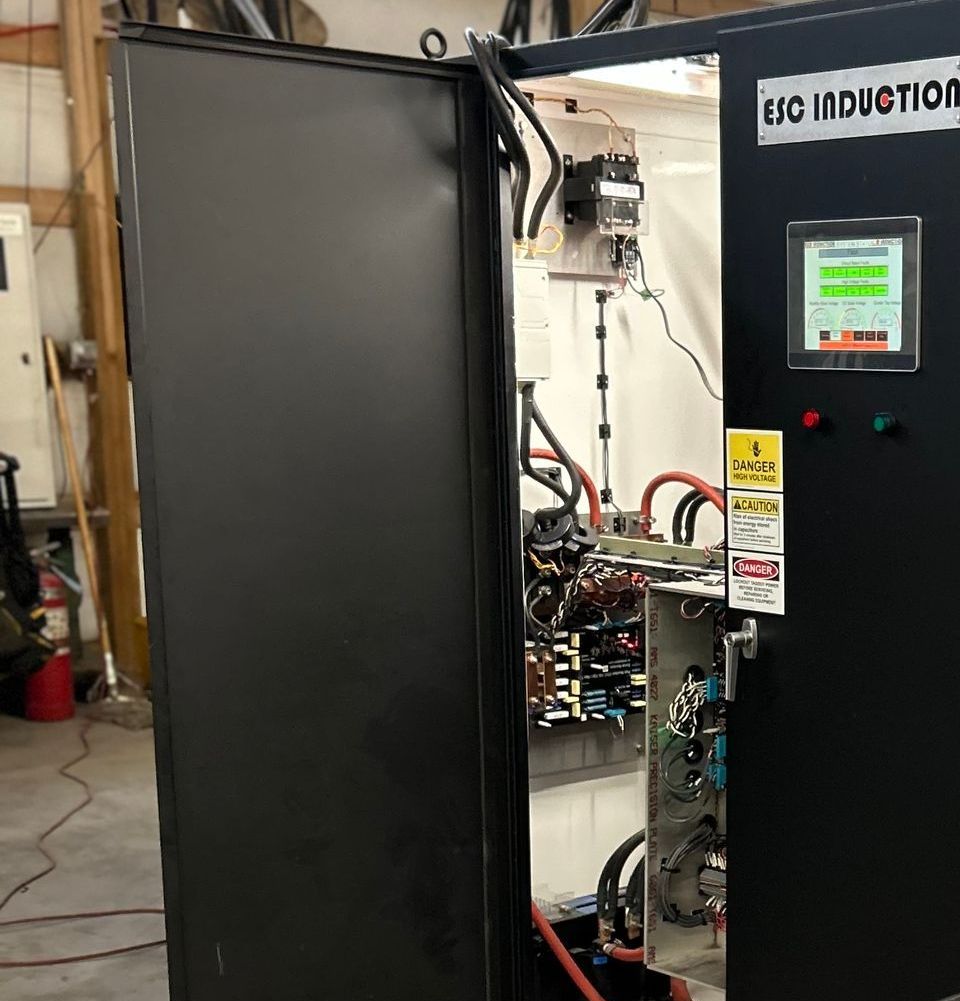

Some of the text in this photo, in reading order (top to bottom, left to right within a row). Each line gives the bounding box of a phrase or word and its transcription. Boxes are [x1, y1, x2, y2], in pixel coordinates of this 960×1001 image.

[764, 77, 960, 125] ESC INDUCTION
[733, 459, 776, 473] DANGER
[748, 474, 776, 482] VOLTAGE
[742, 500, 778, 512] CAUTION
[739, 563, 772, 575] DANGER
